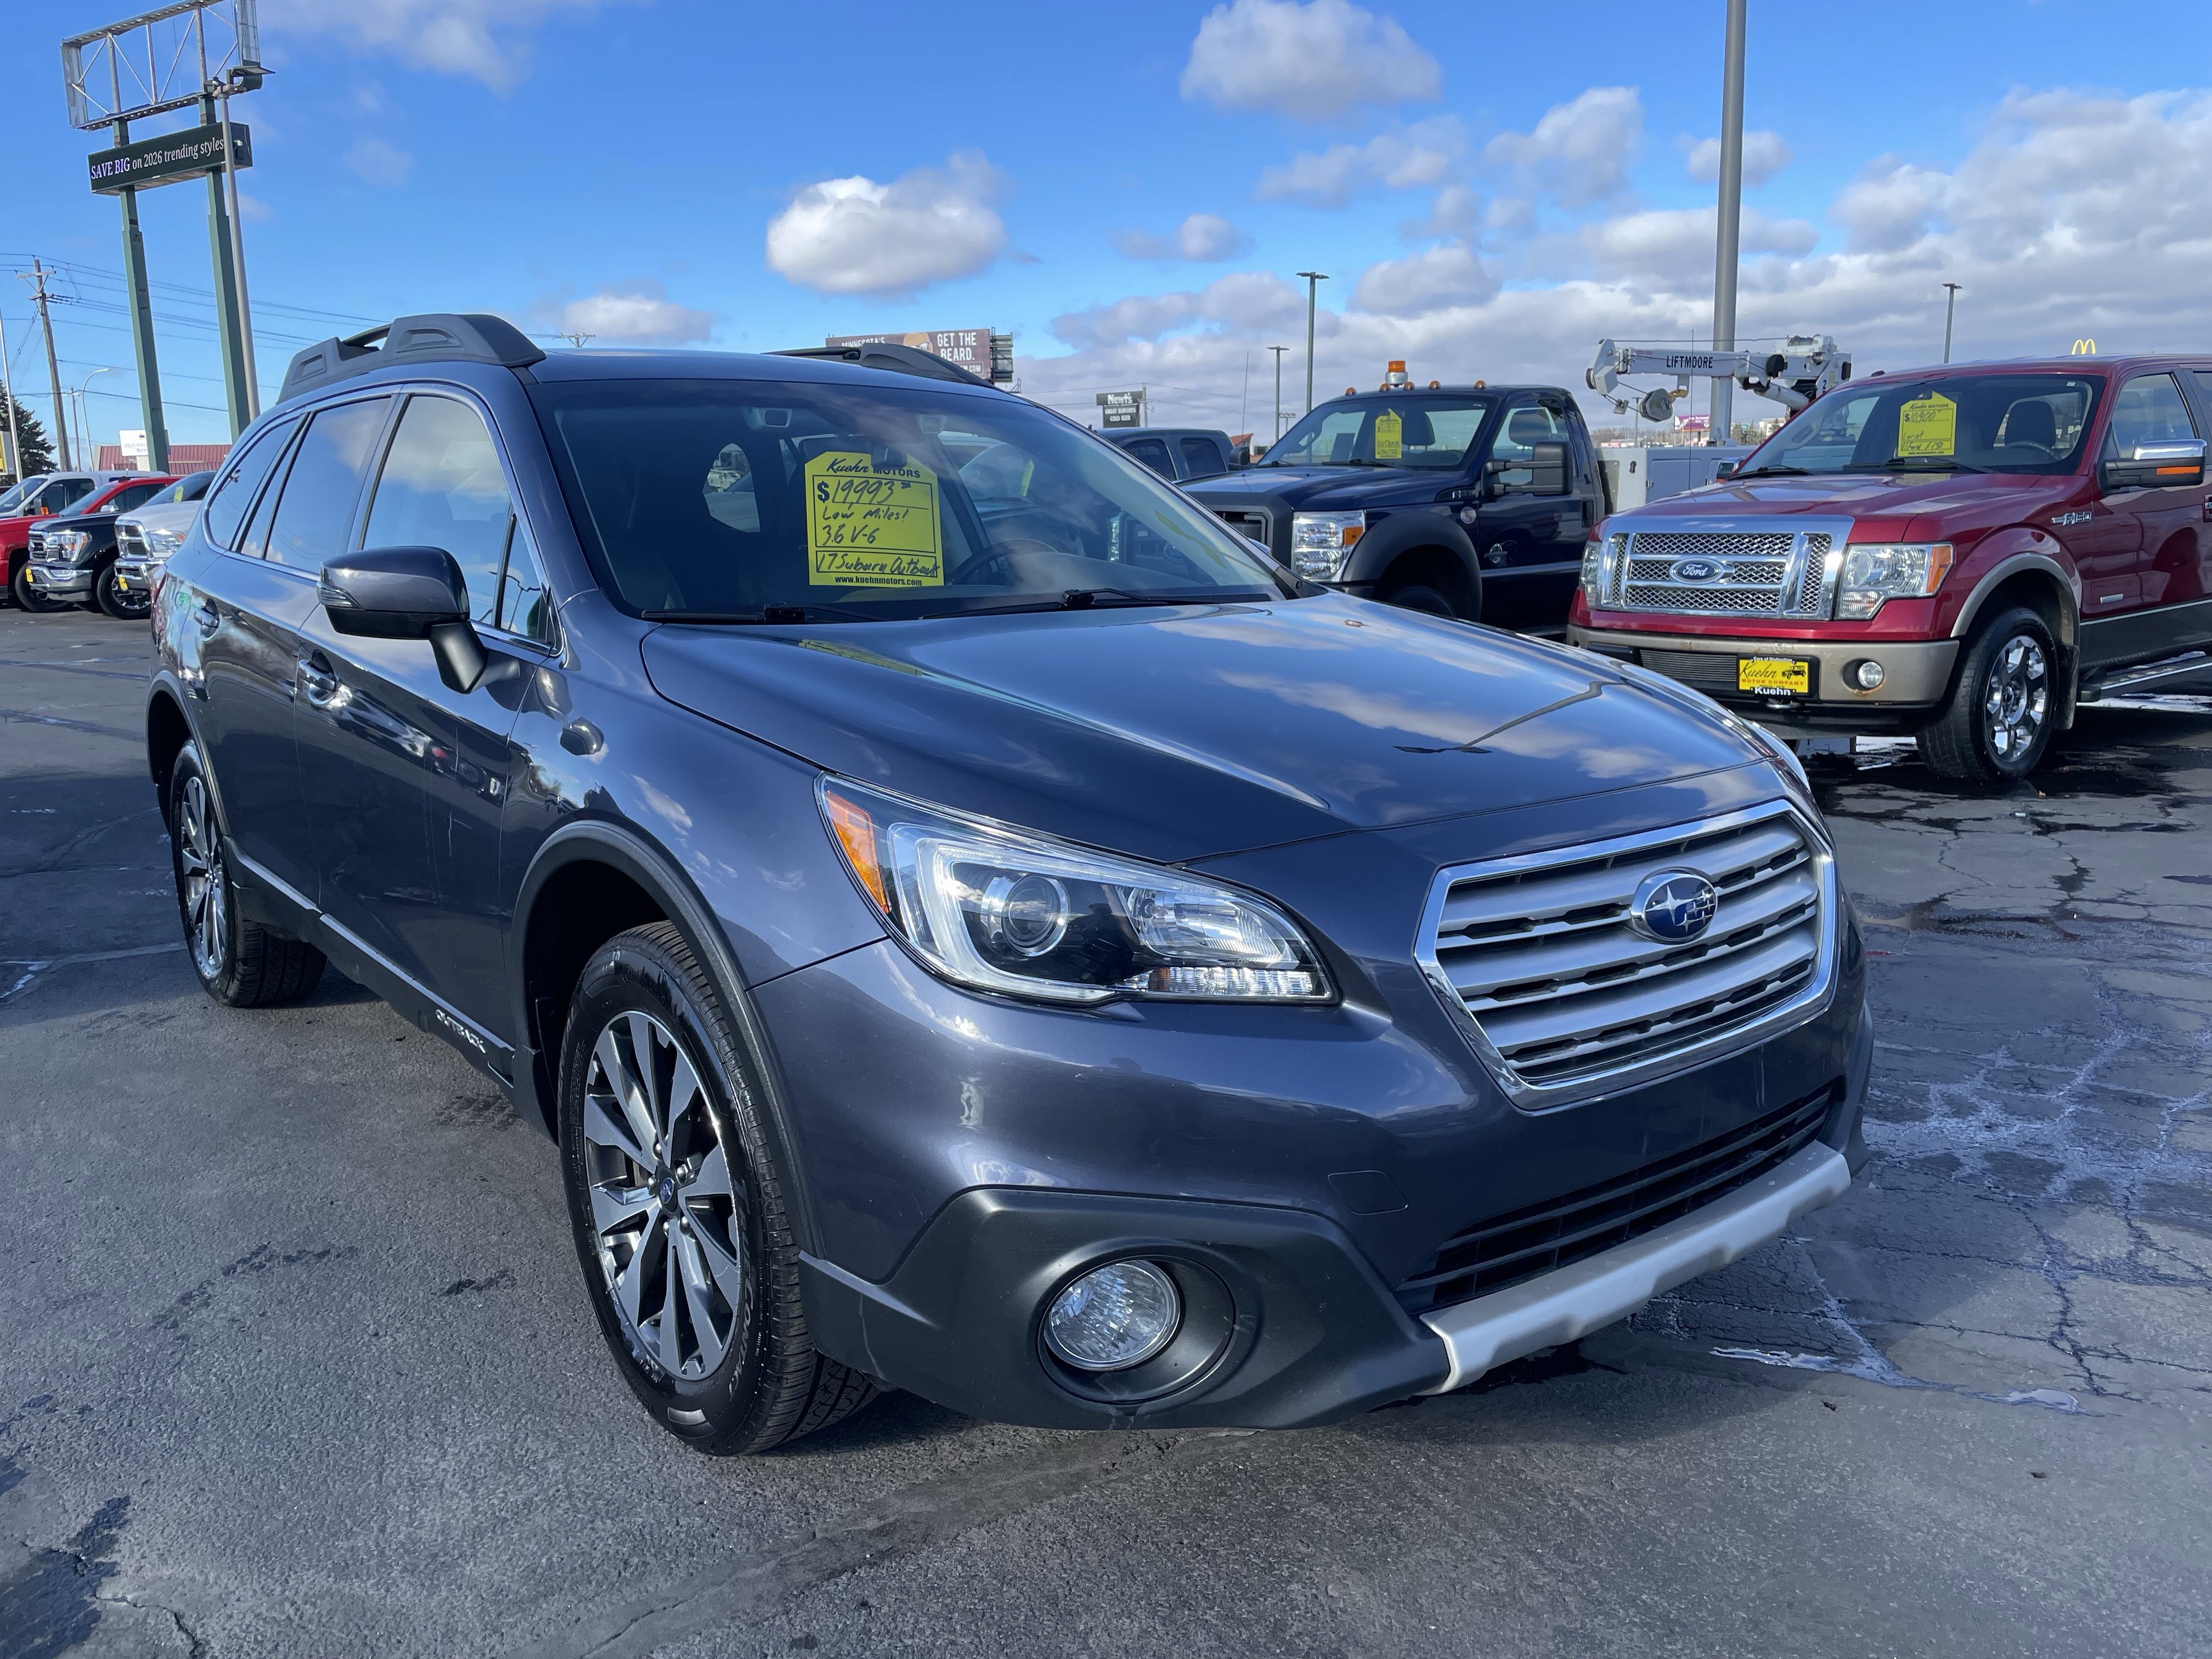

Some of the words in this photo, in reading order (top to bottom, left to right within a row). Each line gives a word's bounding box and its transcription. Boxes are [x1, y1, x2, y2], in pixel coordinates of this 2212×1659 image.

[91, 161, 113, 179] SAVE
[114, 157, 130, 174] BIG
[132, 159, 142, 170] on
[144, 150, 162, 168] 2026
[164, 142, 199, 163] trending
[200, 137, 224, 157] styles
[937, 333, 955, 347] GET
[959, 332, 977, 346] THE
[940, 348, 975, 362] BEARD.
[1666, 356, 1713, 370] LIFTMOORE
[1107, 392, 1133, 404] Newt's
[826, 458, 869, 473] Kuehn
[823, 505, 854, 521] Low
[822, 523, 846, 546] 3.6
[850, 524, 880, 544] V-6
[1682, 563, 1708, 576] Ford
[835, 576, 922, 586] www.kuehnmotors.com
[1739, 662, 1778, 678] Kuehn
[1754, 687, 1791, 696] Kuehn
